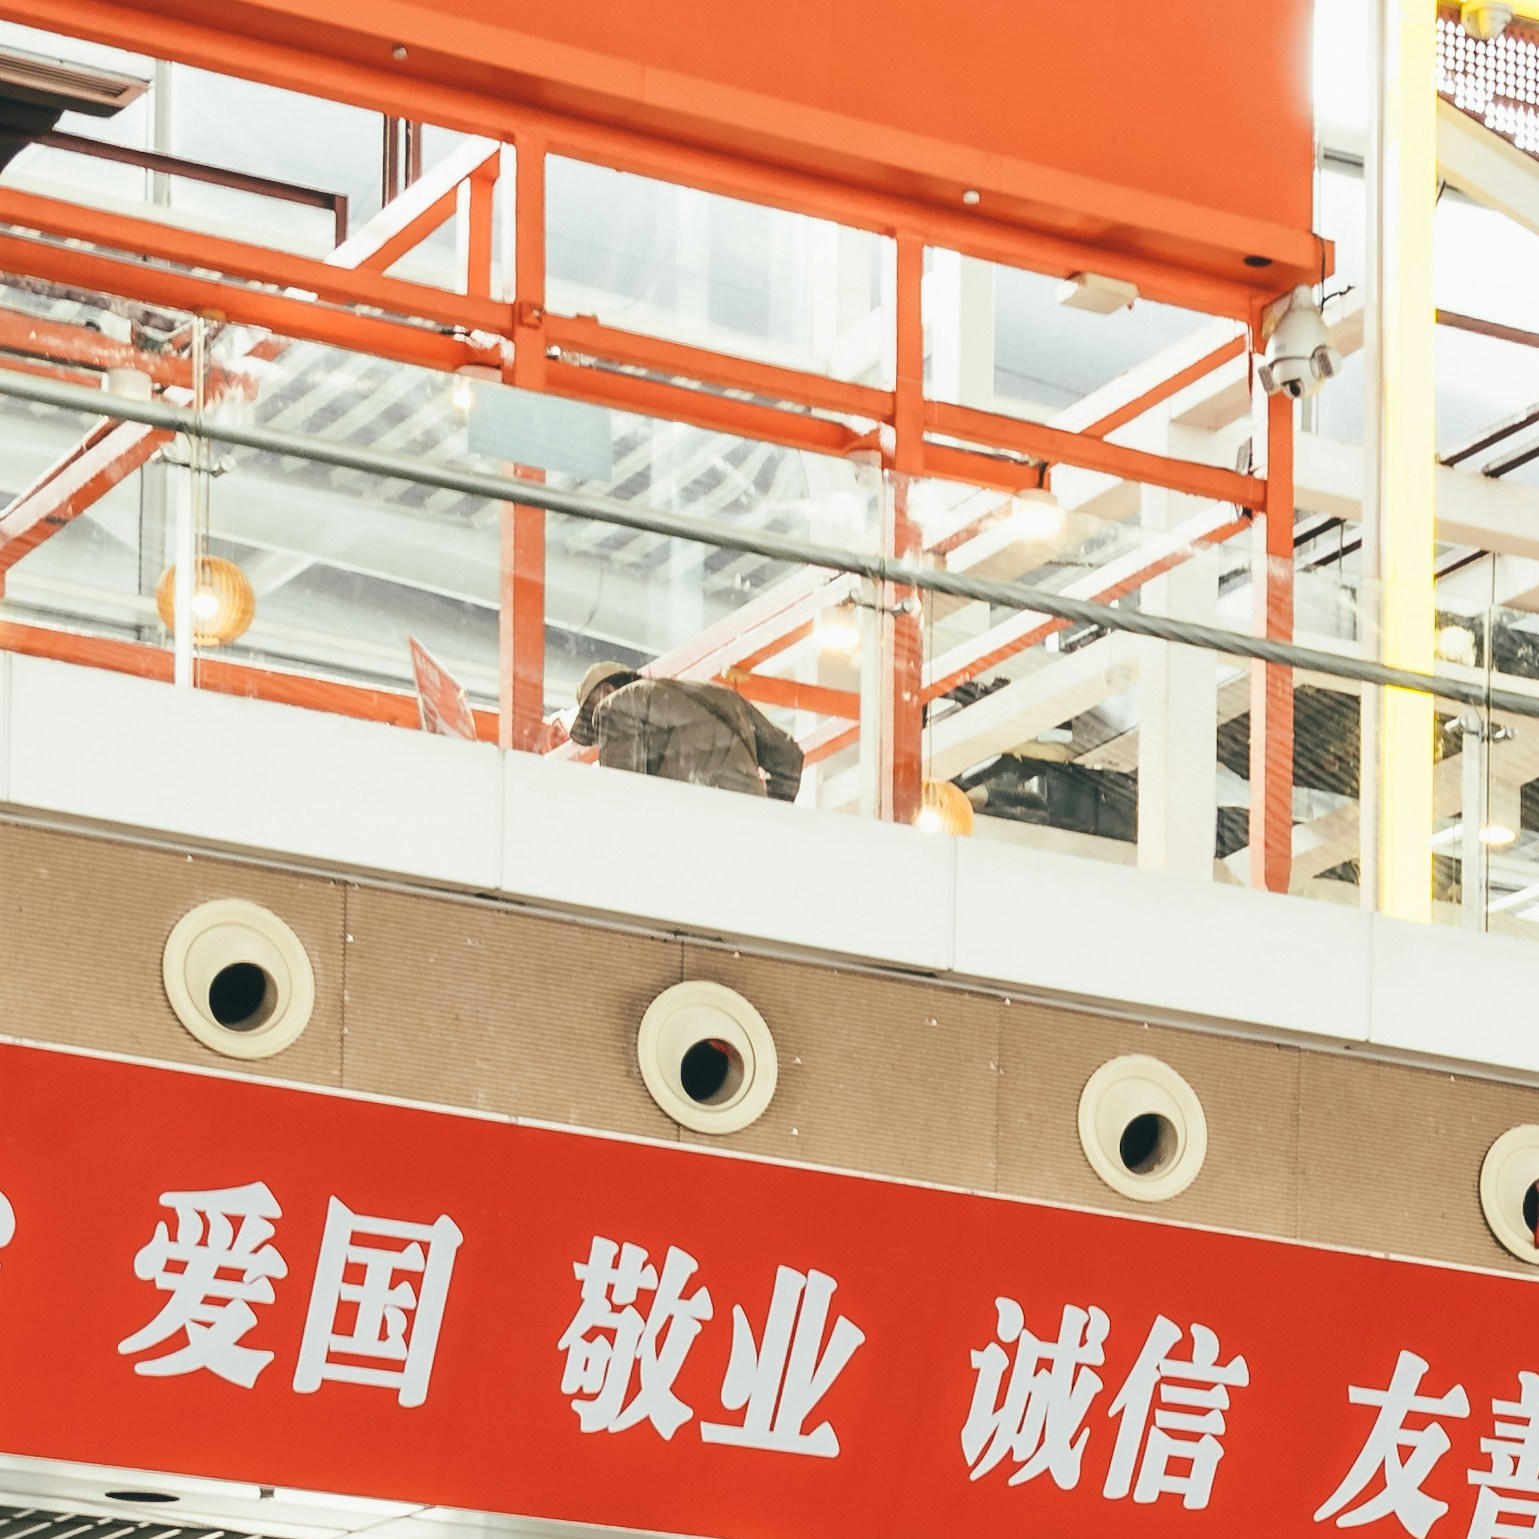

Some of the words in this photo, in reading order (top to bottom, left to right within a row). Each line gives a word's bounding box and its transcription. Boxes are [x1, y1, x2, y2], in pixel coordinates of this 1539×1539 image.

[117, 1180, 465, 1408] 爱国
[557, 1234, 866, 1458] 敬业
[961, 1295, 1250, 1510] 诚信
